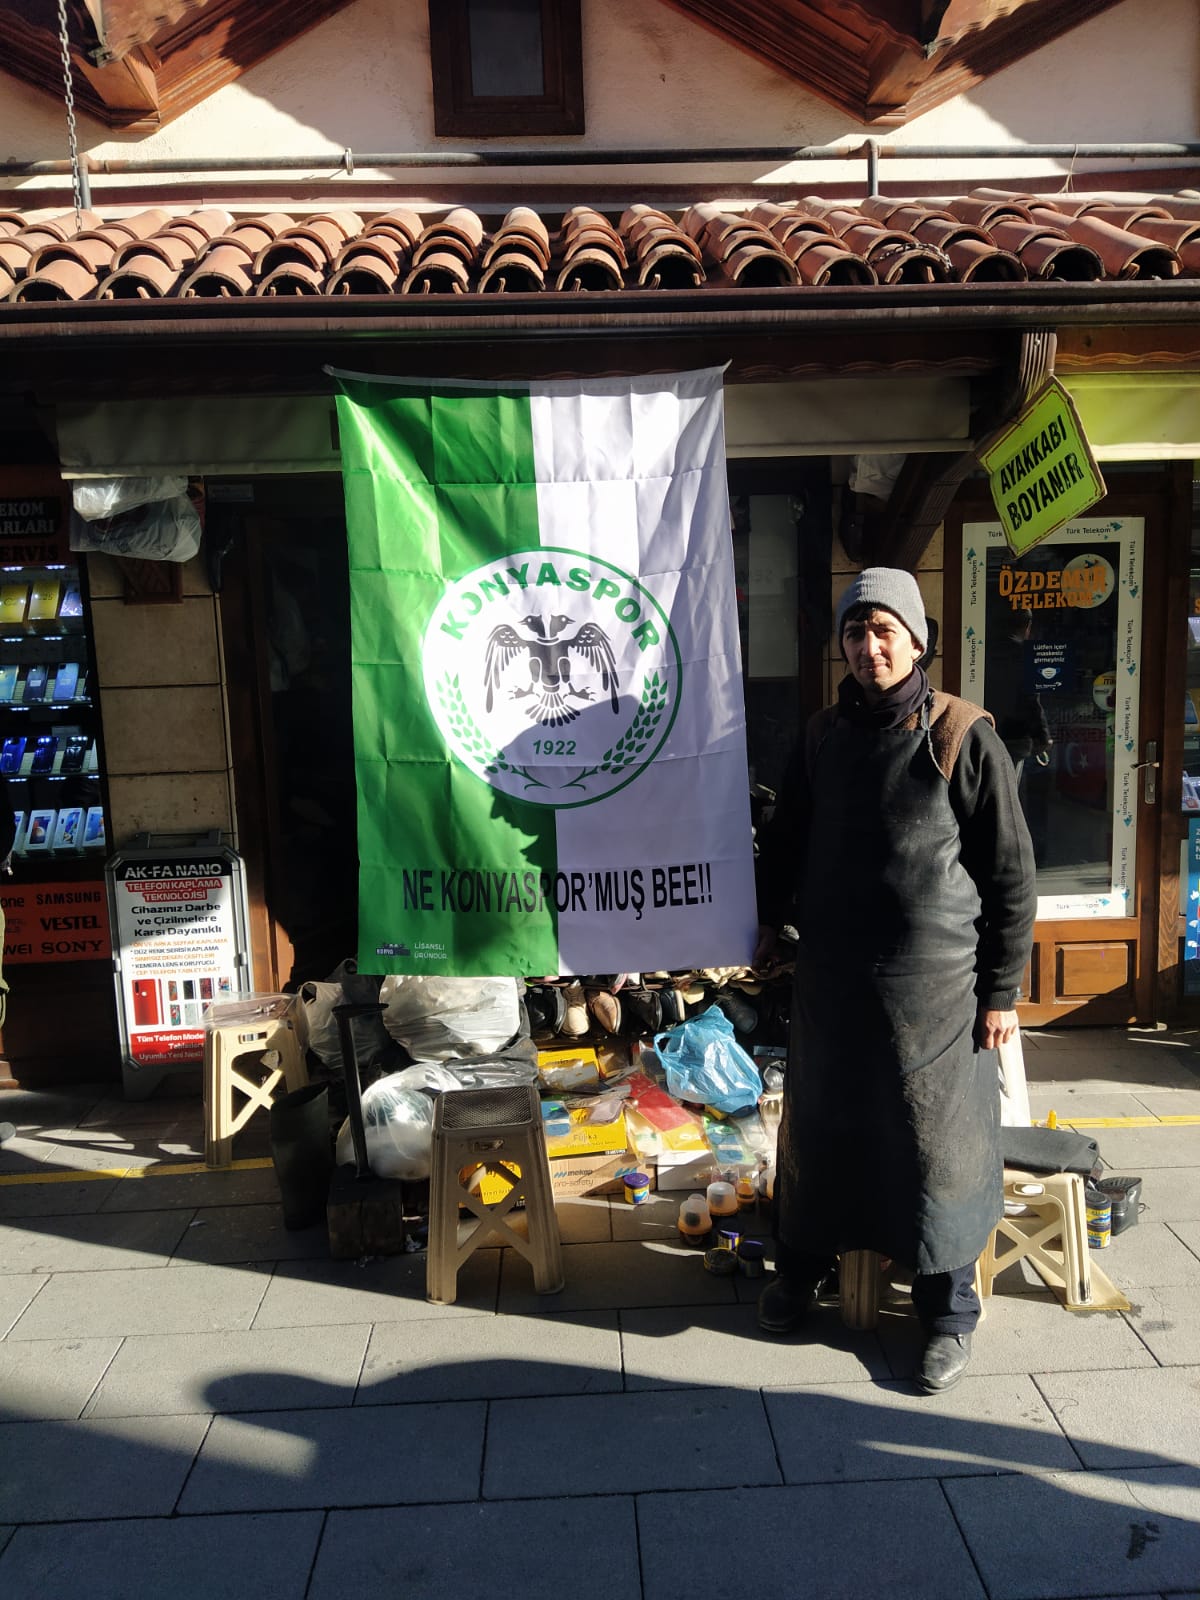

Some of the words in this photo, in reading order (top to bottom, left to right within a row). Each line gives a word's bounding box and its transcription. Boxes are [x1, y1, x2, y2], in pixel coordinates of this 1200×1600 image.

[1001, 415, 1067, 495] AYAKKABI
[1007, 452, 1085, 531] BOYANIR
[1066, 527, 1081, 535] Türk
[1082, 526, 1111, 535] Telekom
[970, 559, 978, 586] Telekom
[1000, 565, 1106, 597] ÖZDEMİR
[440, 562, 660, 652] KONYASPOR
[1009, 592, 1094, 610] TELEKOM
[532, 739, 576, 756] 1922
[125, 865, 173, 879] AK-FA
[176, 863, 222, 877] NANO
[128, 882, 171, 892] TELEFON
[171, 879, 221, 890] KAPLAMA
[402, 870, 433, 912] NE
[441, 868, 645, 920] KONYASPOR'MUŞ
[654, 863, 712, 909] BEE!!
[36, 892, 101, 905] SAMSUNG
[131, 905, 183, 914] Cihazınız
[185, 903, 221, 912] Darbe
[40, 915, 103, 930] VESTEL
[137, 918, 152, 926] ve
[154, 915, 217, 927] Çizilmelere
[168, 925, 222, 936] Dayanıklı
[41, 940, 103, 954] SONY
[414, 941, 445, 951] LİSANSLI
[137, 1035, 153, 1043] Tüm
[154, 1034, 182, 1042] Telefon
